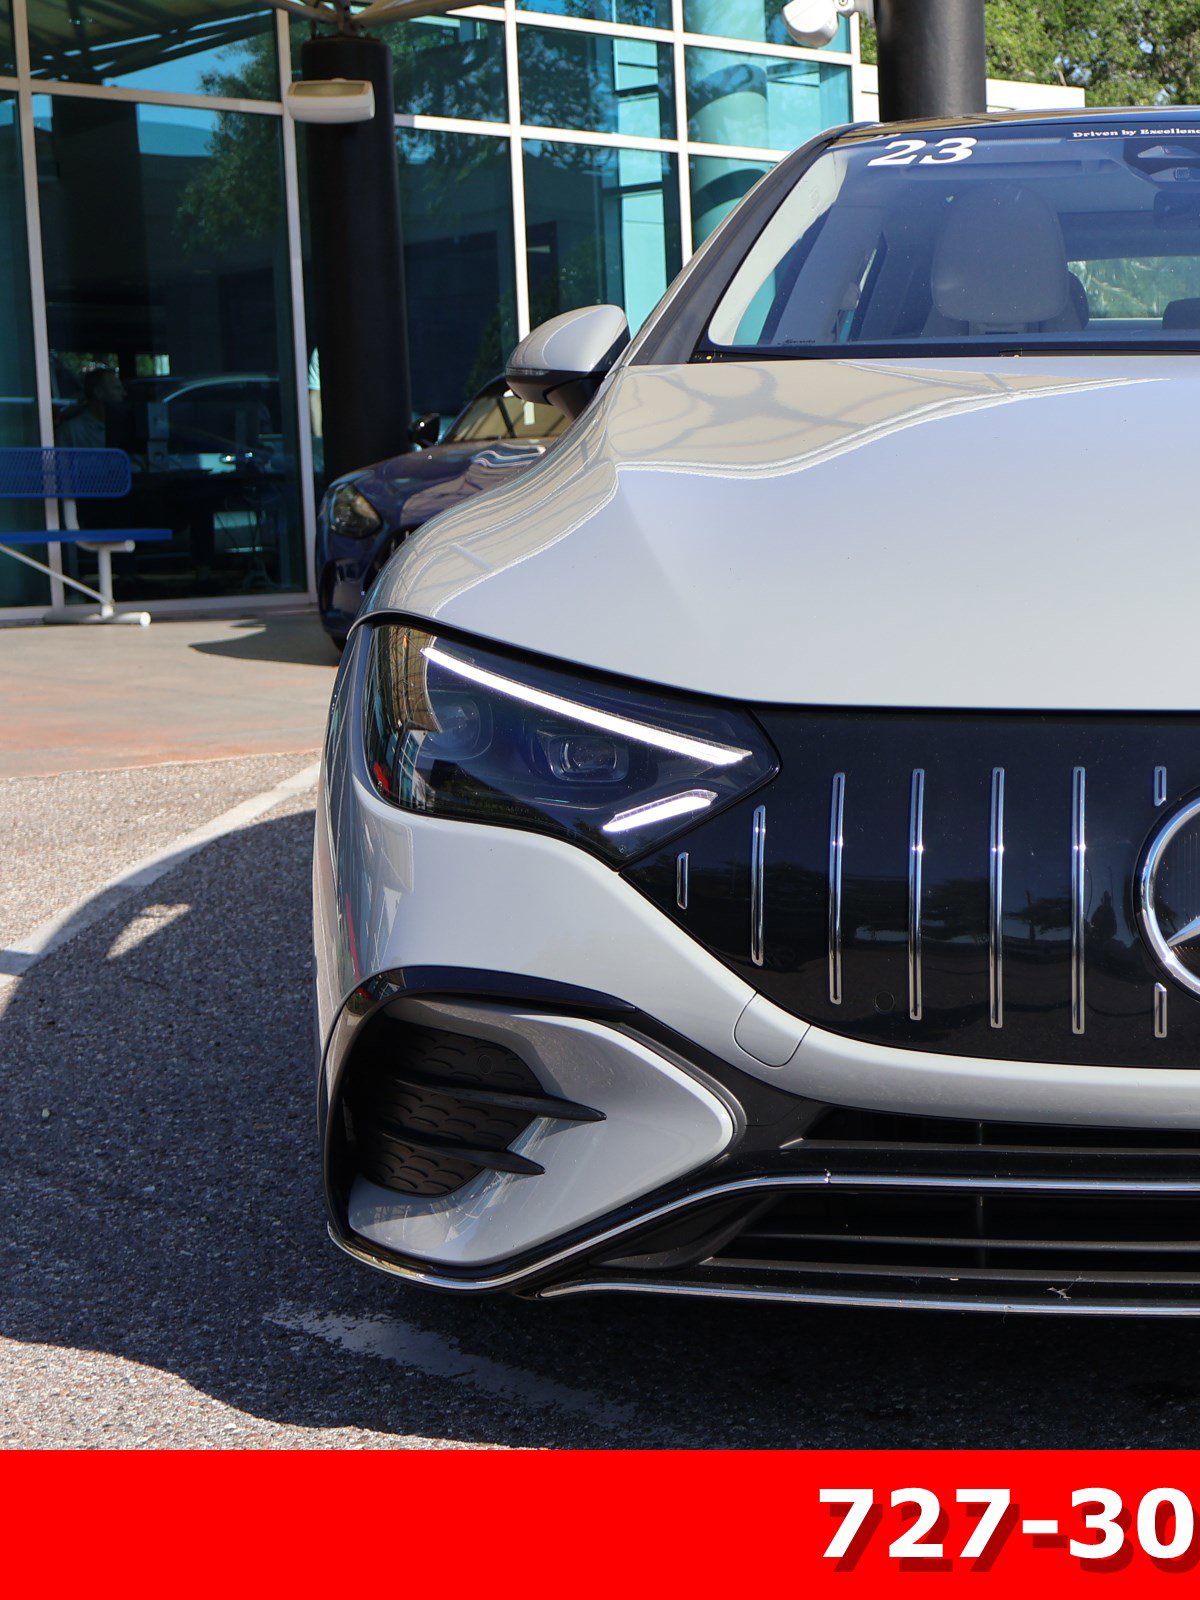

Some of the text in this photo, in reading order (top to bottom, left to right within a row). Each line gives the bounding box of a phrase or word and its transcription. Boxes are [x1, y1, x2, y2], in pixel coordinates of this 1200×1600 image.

[1072, 130, 1119, 138] Driven
[1121, 129, 1137, 137] by
[867, 137, 977, 166] 23
